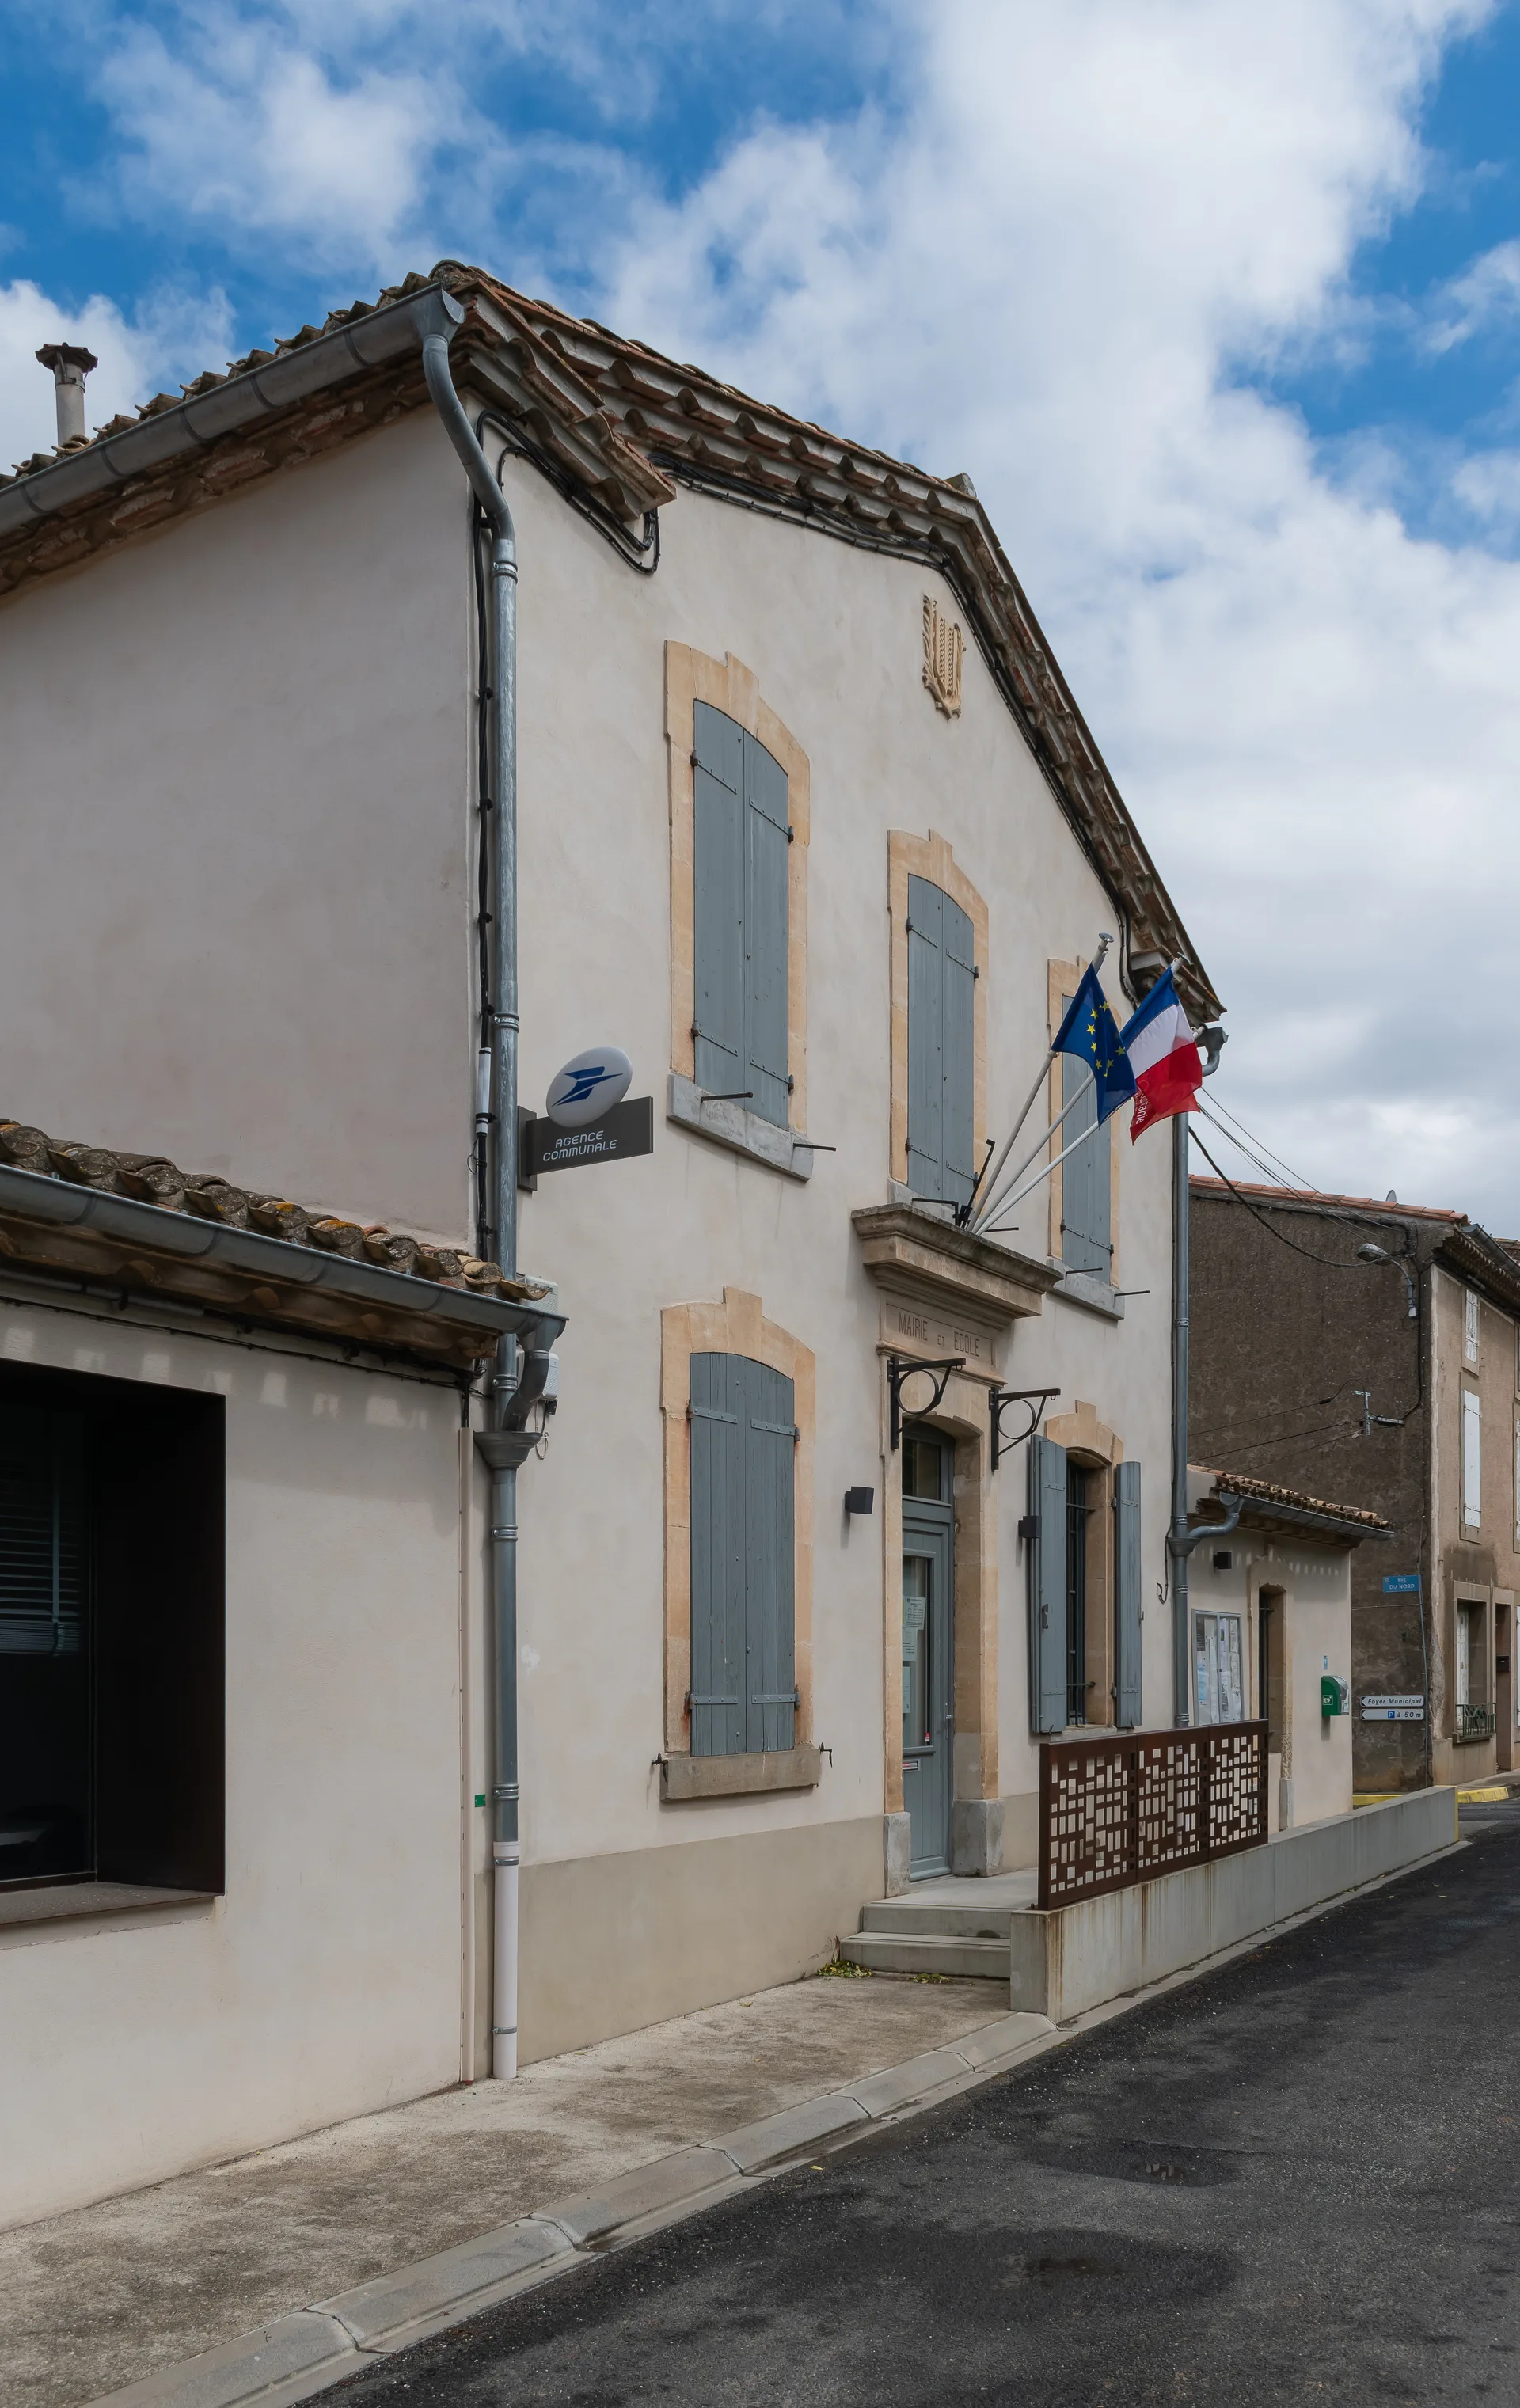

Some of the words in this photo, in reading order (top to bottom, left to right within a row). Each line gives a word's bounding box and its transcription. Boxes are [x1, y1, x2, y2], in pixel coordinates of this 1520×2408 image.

[542, 1139, 618, 1161] COMMUNALE
[555, 1130, 604, 1148] AGENCE
[899, 1312, 928, 1341] MAIRIE
[937, 1335, 945, 1346] ET
[953, 1331, 980, 1358] ECOLE
